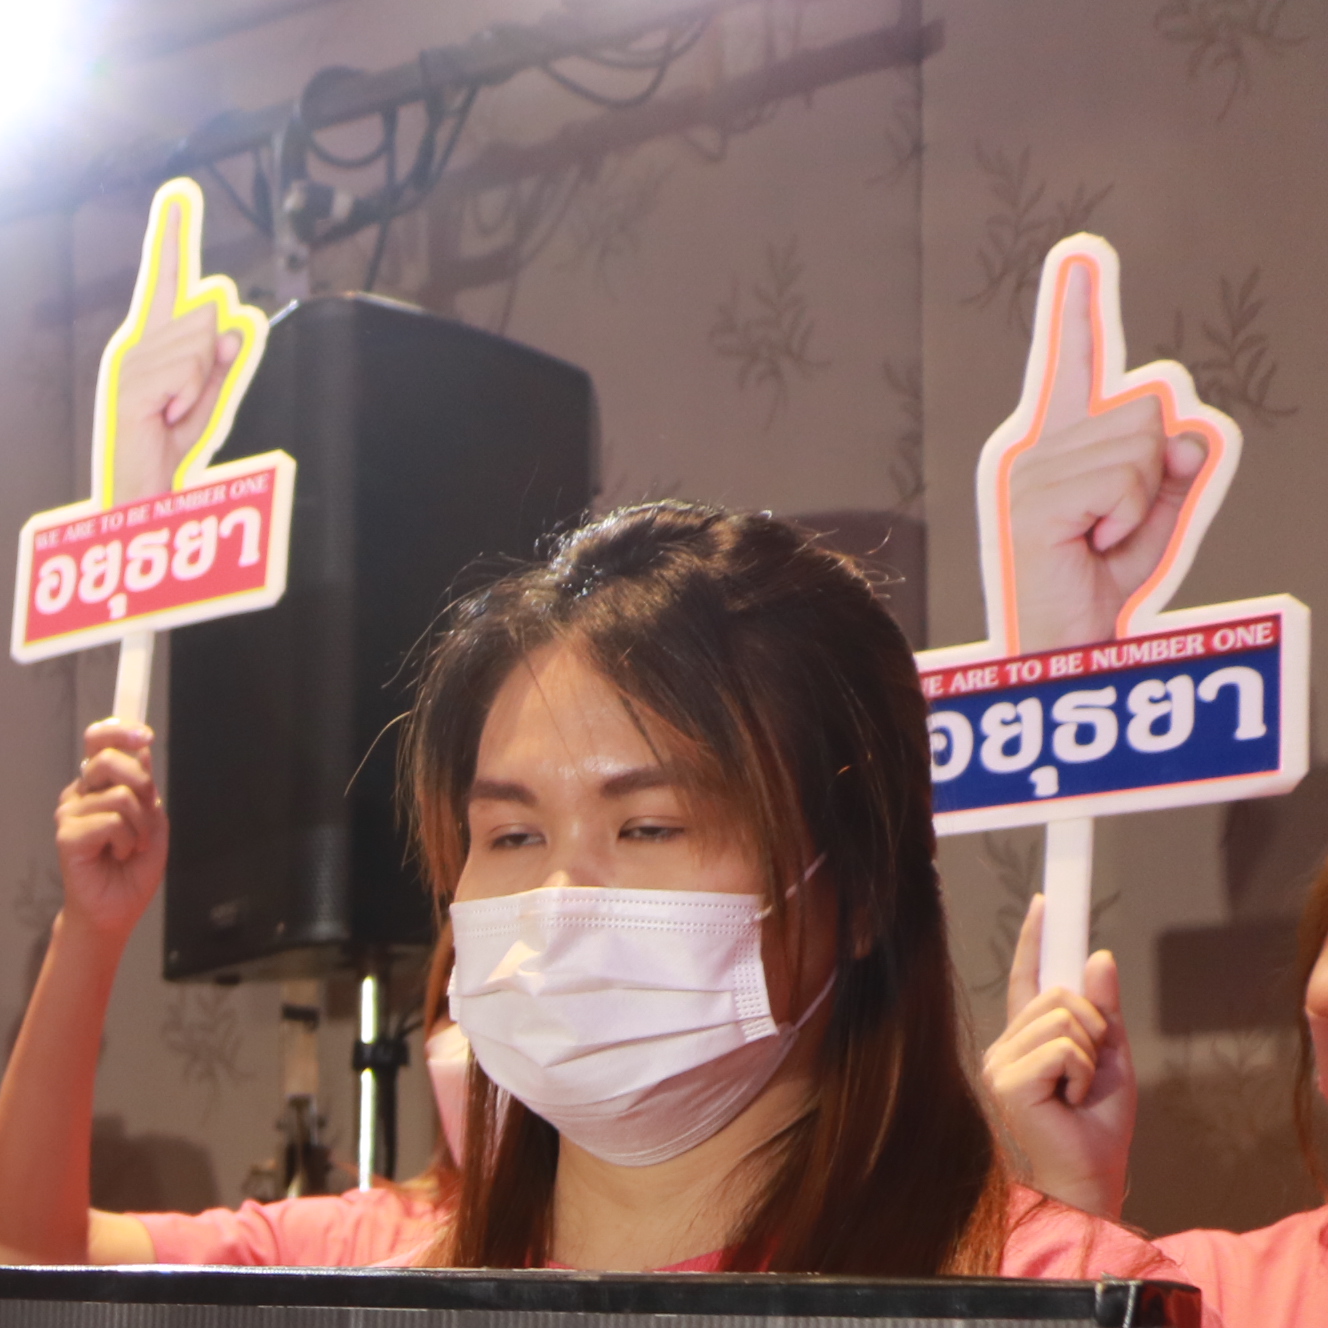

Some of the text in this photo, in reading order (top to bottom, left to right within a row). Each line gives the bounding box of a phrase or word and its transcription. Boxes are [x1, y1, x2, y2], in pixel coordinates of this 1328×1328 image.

[36, 472, 268, 551] WE ARE TO BE NUMBER ONE
[34, 505, 262, 621] อยุธยา
[950, 666, 999, 694] ARE
[1005, 657, 1043, 685] TO
[1049, 648, 1085, 677] BE
[1091, 632, 1206, 667] NUMBER
[1212, 620, 1274, 652] ONE
[926, 665, 1268, 799] อยุธยา
